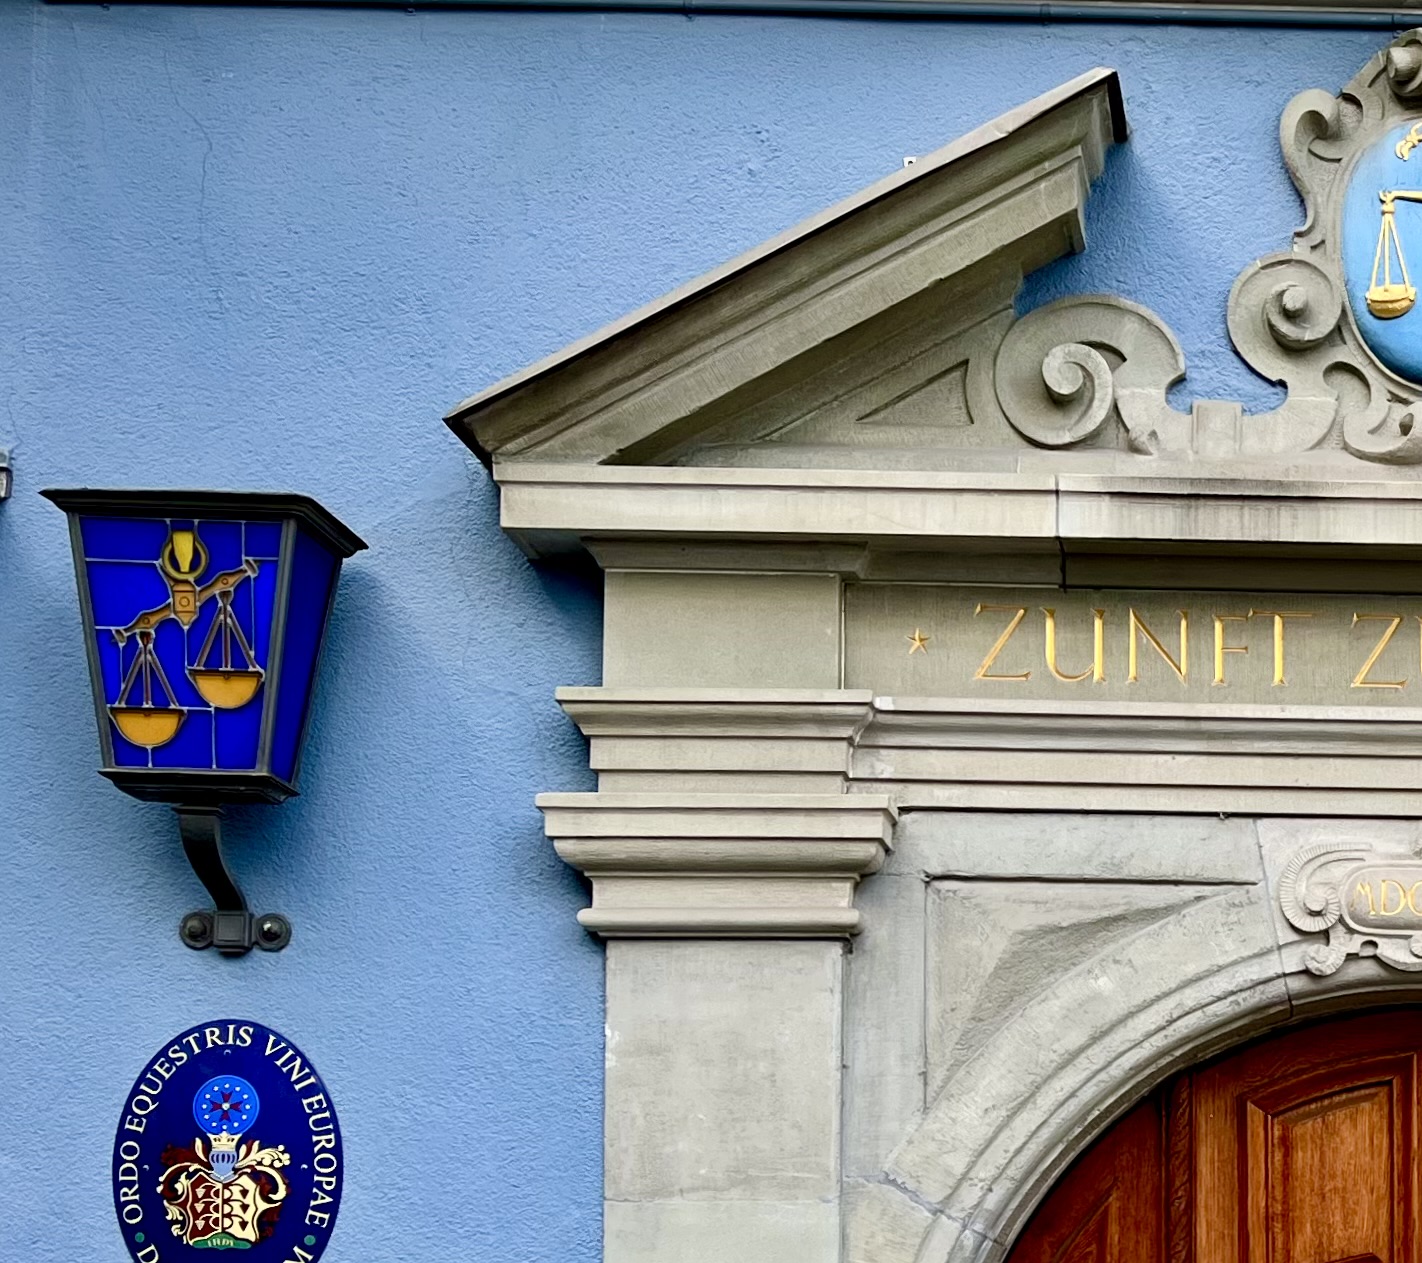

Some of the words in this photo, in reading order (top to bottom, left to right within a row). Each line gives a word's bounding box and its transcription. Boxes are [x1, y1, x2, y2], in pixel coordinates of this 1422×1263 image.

[973, 602, 1316, 686] ZUNFT
[125, 1024, 254, 1134] EQUESTRIS
[264, 1034, 316, 1092] VINI
[119, 1139, 143, 1225] ORDO
[302, 1092, 337, 1228] EUROPAE
